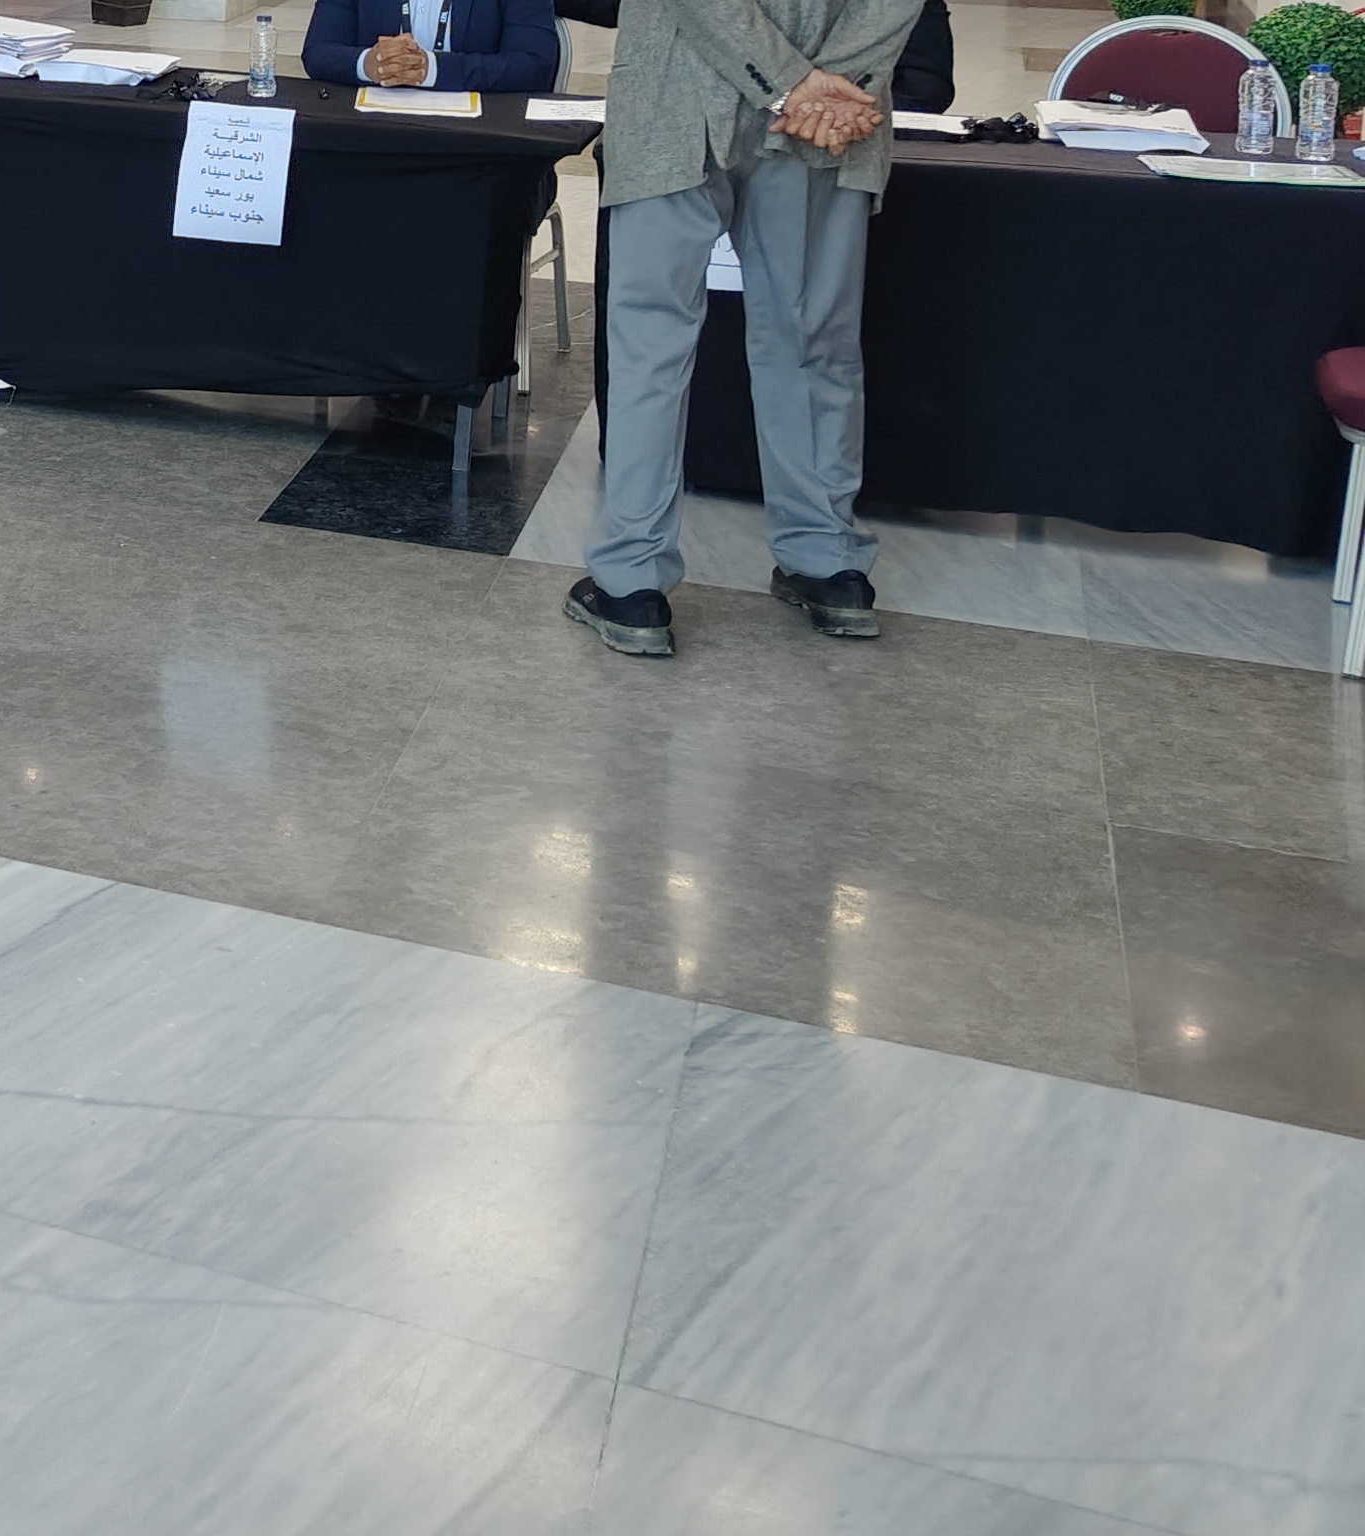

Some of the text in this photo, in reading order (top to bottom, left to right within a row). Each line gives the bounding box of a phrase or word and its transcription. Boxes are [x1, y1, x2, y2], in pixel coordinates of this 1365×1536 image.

[212, 128, 262, 144] الشرقية
[200, 165, 264, 182] شمال سيناء
[204, 185, 255, 203] بور سعيد
[190, 203, 264, 224] جنوب سيناء
